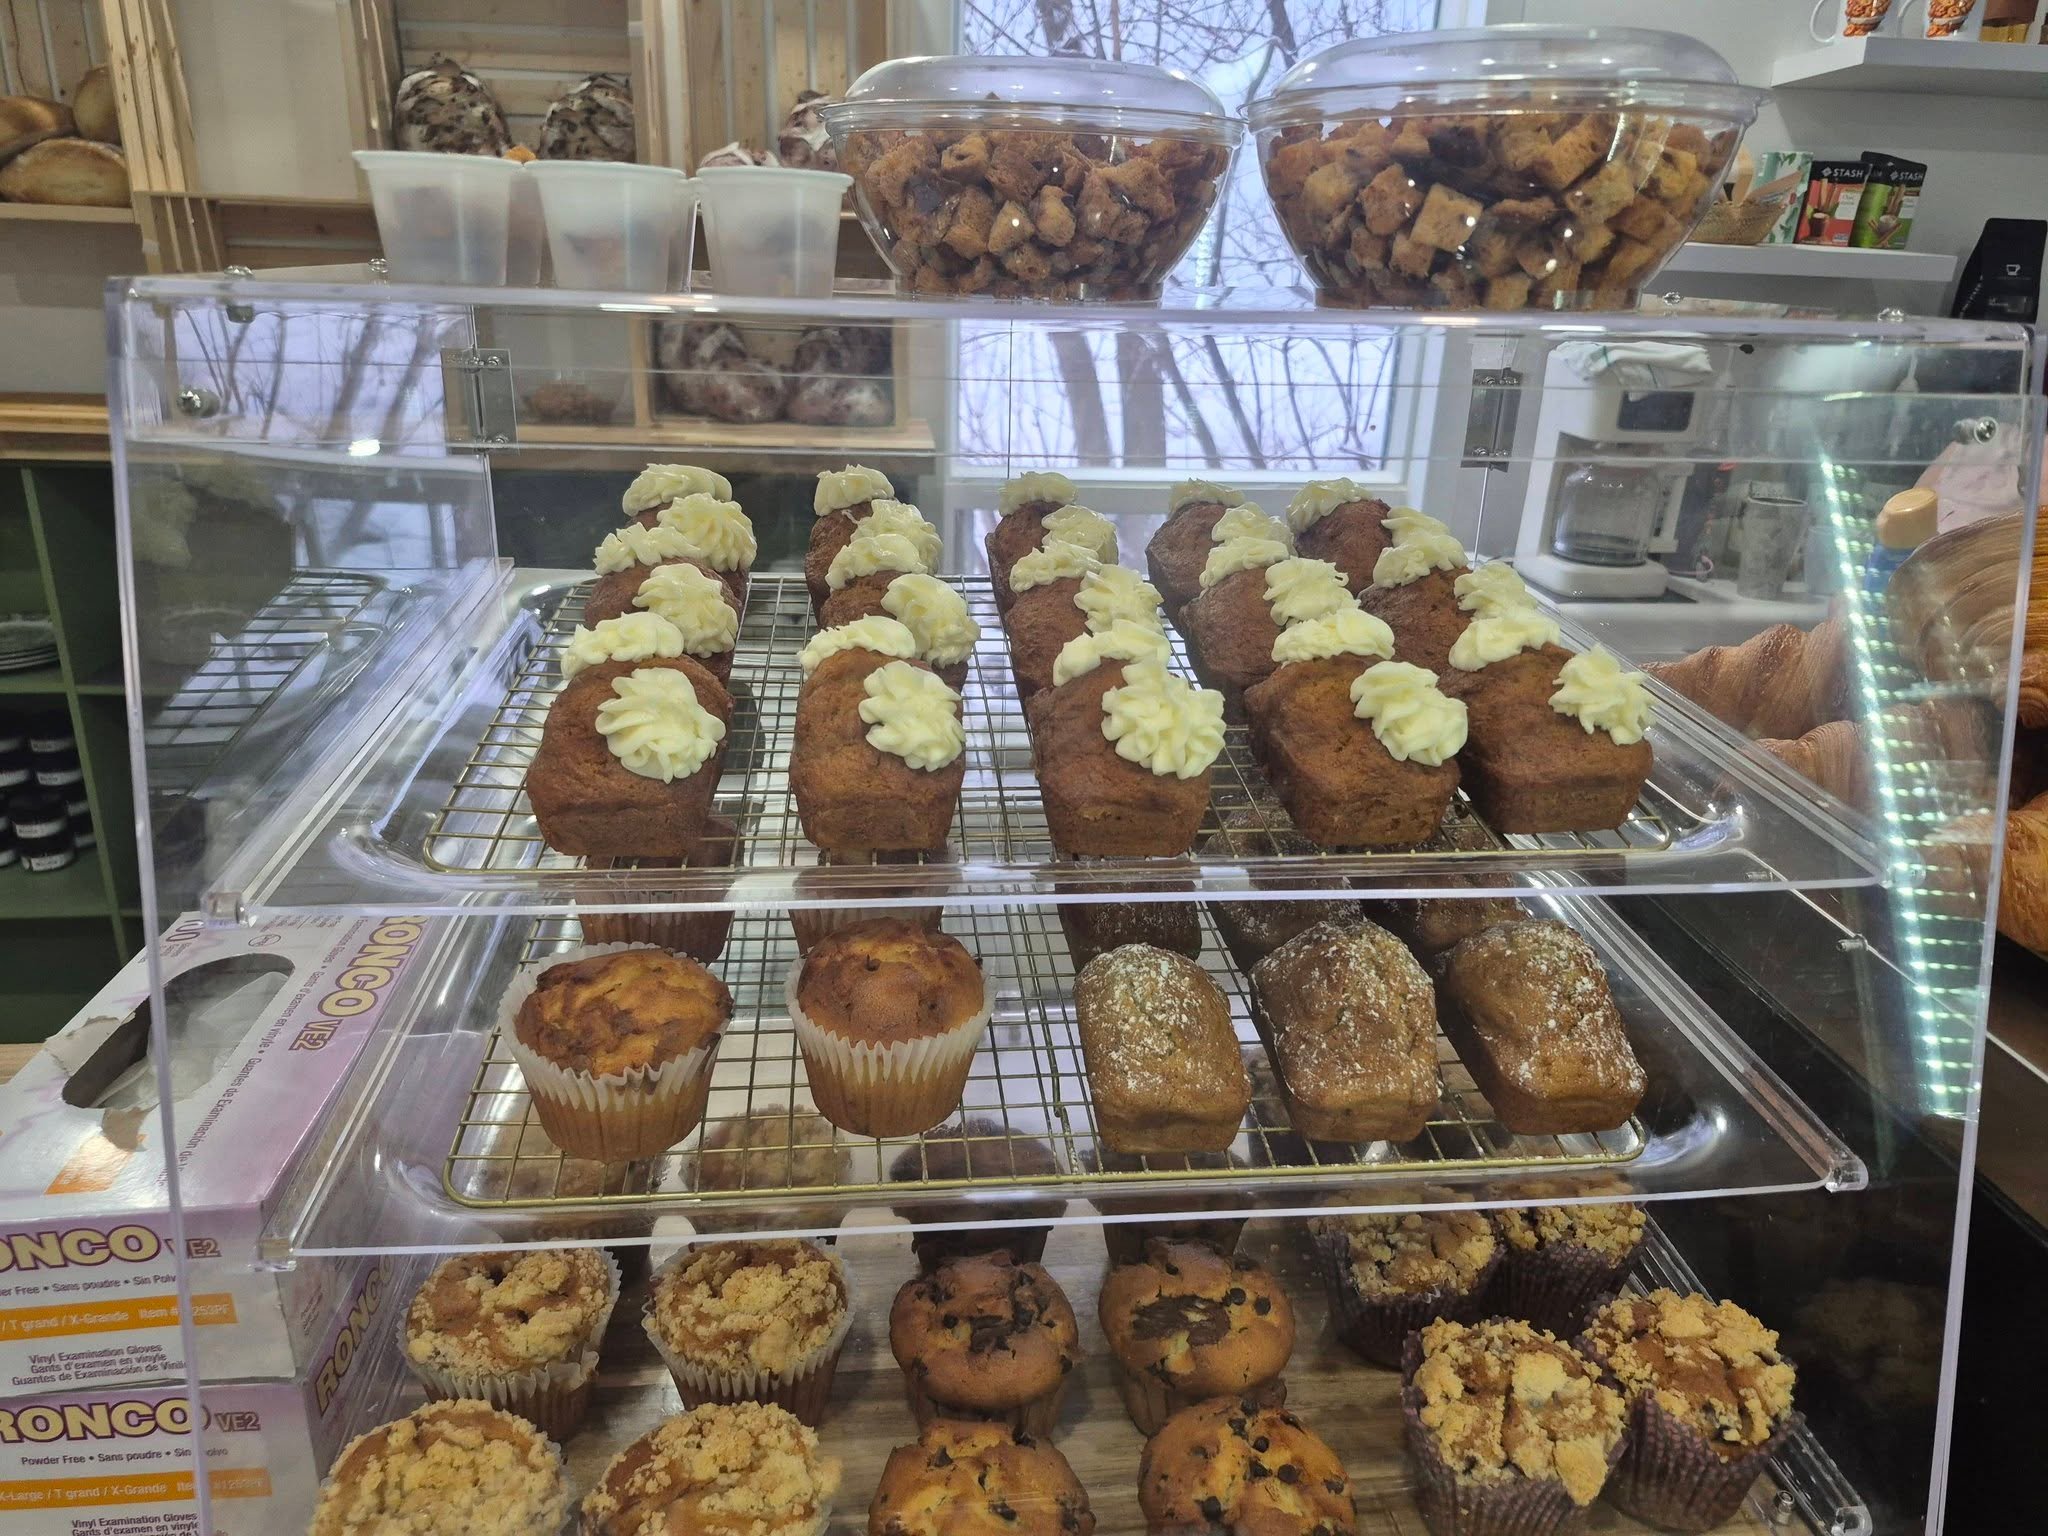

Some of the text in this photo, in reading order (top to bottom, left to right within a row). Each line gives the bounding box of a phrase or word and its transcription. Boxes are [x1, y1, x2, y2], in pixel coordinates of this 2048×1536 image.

[1832, 168, 1864, 177] STASH
[1899, 171, 1923, 181] STASH
[303, 971, 326, 988] Gants
[274, 1018, 288, 1027] en
[259, 1027, 282, 1048] vinyle
[288, 1019, 344, 1051] VE2
[231, 1057, 262, 1087] Guantes
[222, 1087, 240, 1098] de
[15, 1285, 41, 1296] Free
[52, 1281, 80, 1293] Sans
[83, 1278, 121, 1292] poudre
[132, 1275, 151, 1286] Sin
[153, 1273, 177, 1284] Polv
[21, 1315, 59, 1333] grand
[70, 1311, 129, 1327] X-Grande
[29, 1344, 163, 1365] Vinyl Examination Gloves
[31, 1353, 168, 1374] Gants d'examen en vinyle
[12, 1359, 187, 1386] Guantes de Examinación de Vinil
[214, 1411, 261, 1433] VE2
[21, 1455, 60, 1466] Powder
[63, 1454, 86, 1465] Free
[98, 1452, 124, 1463] Sans
[127, 1449, 163, 1463] poudre
[174, 1447, 192, 1458] Sin
[53, 1488, 62, 1499] T
[66, 1486, 100, 1500] grand
[111, 1482, 168, 1498] X-Grande
[176, 1481, 194, 1492] Ite
[71, 1512, 198, 1530] Vinyl Examination Gloves
[71, 1528, 102, 1536] Gants
[103, 1525, 153, 1536] d'examen
[155, 1523, 169, 1533] en
